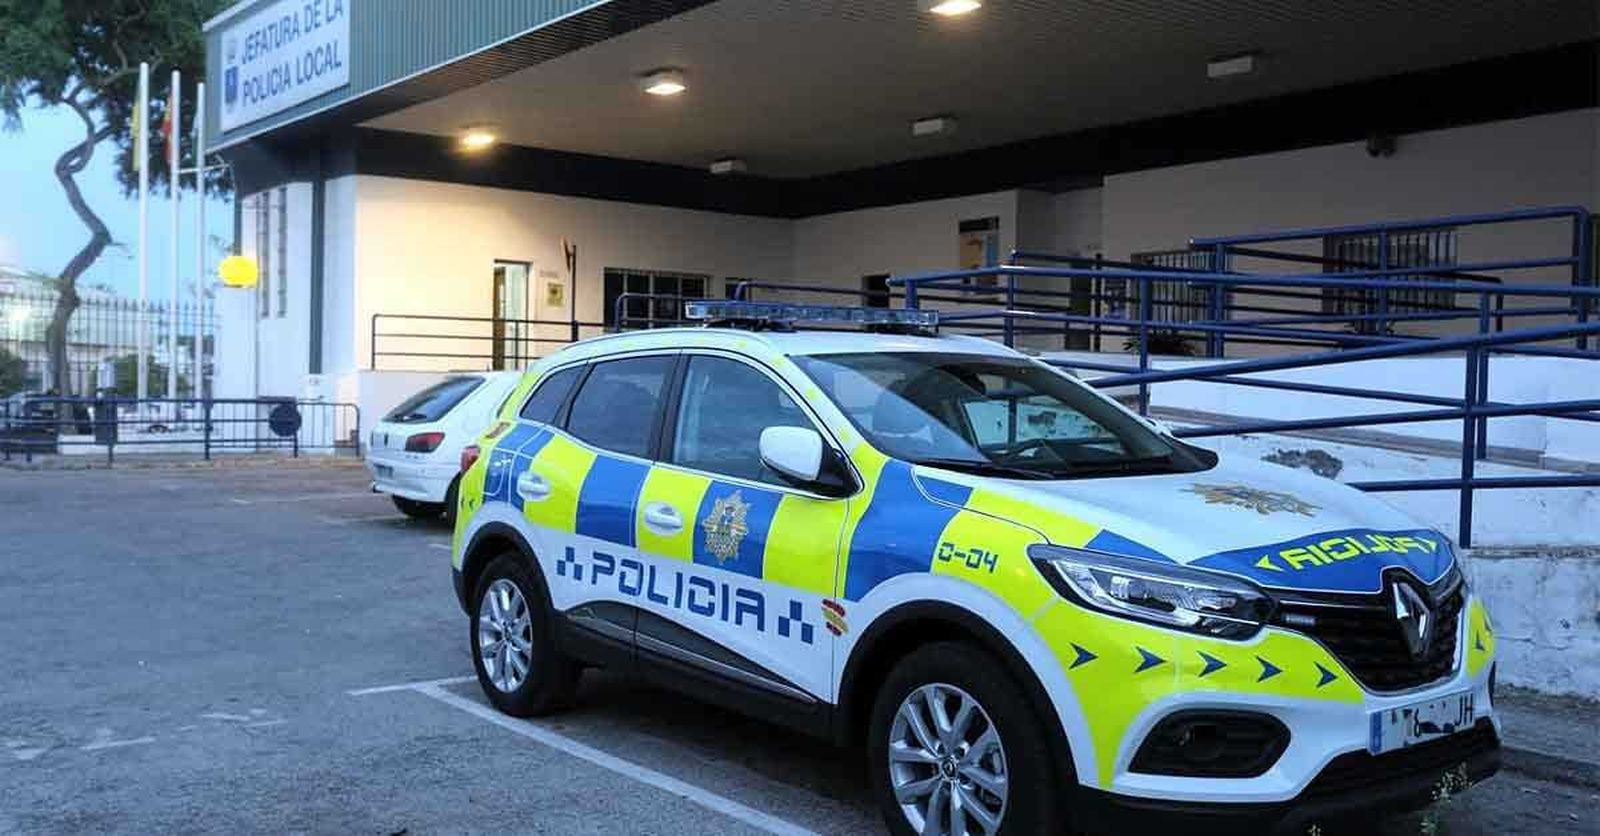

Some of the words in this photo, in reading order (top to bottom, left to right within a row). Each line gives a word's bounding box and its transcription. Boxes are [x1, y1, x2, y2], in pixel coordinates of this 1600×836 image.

[241, 11, 301, 64] JEFATURA
[304, 0, 321, 33] DE
[325, 0, 344, 23] LA
[242, 62, 292, 107] POLICIA
[296, 40, 342, 85] LOCAL
[591, 550, 766, 632] POLICIA
